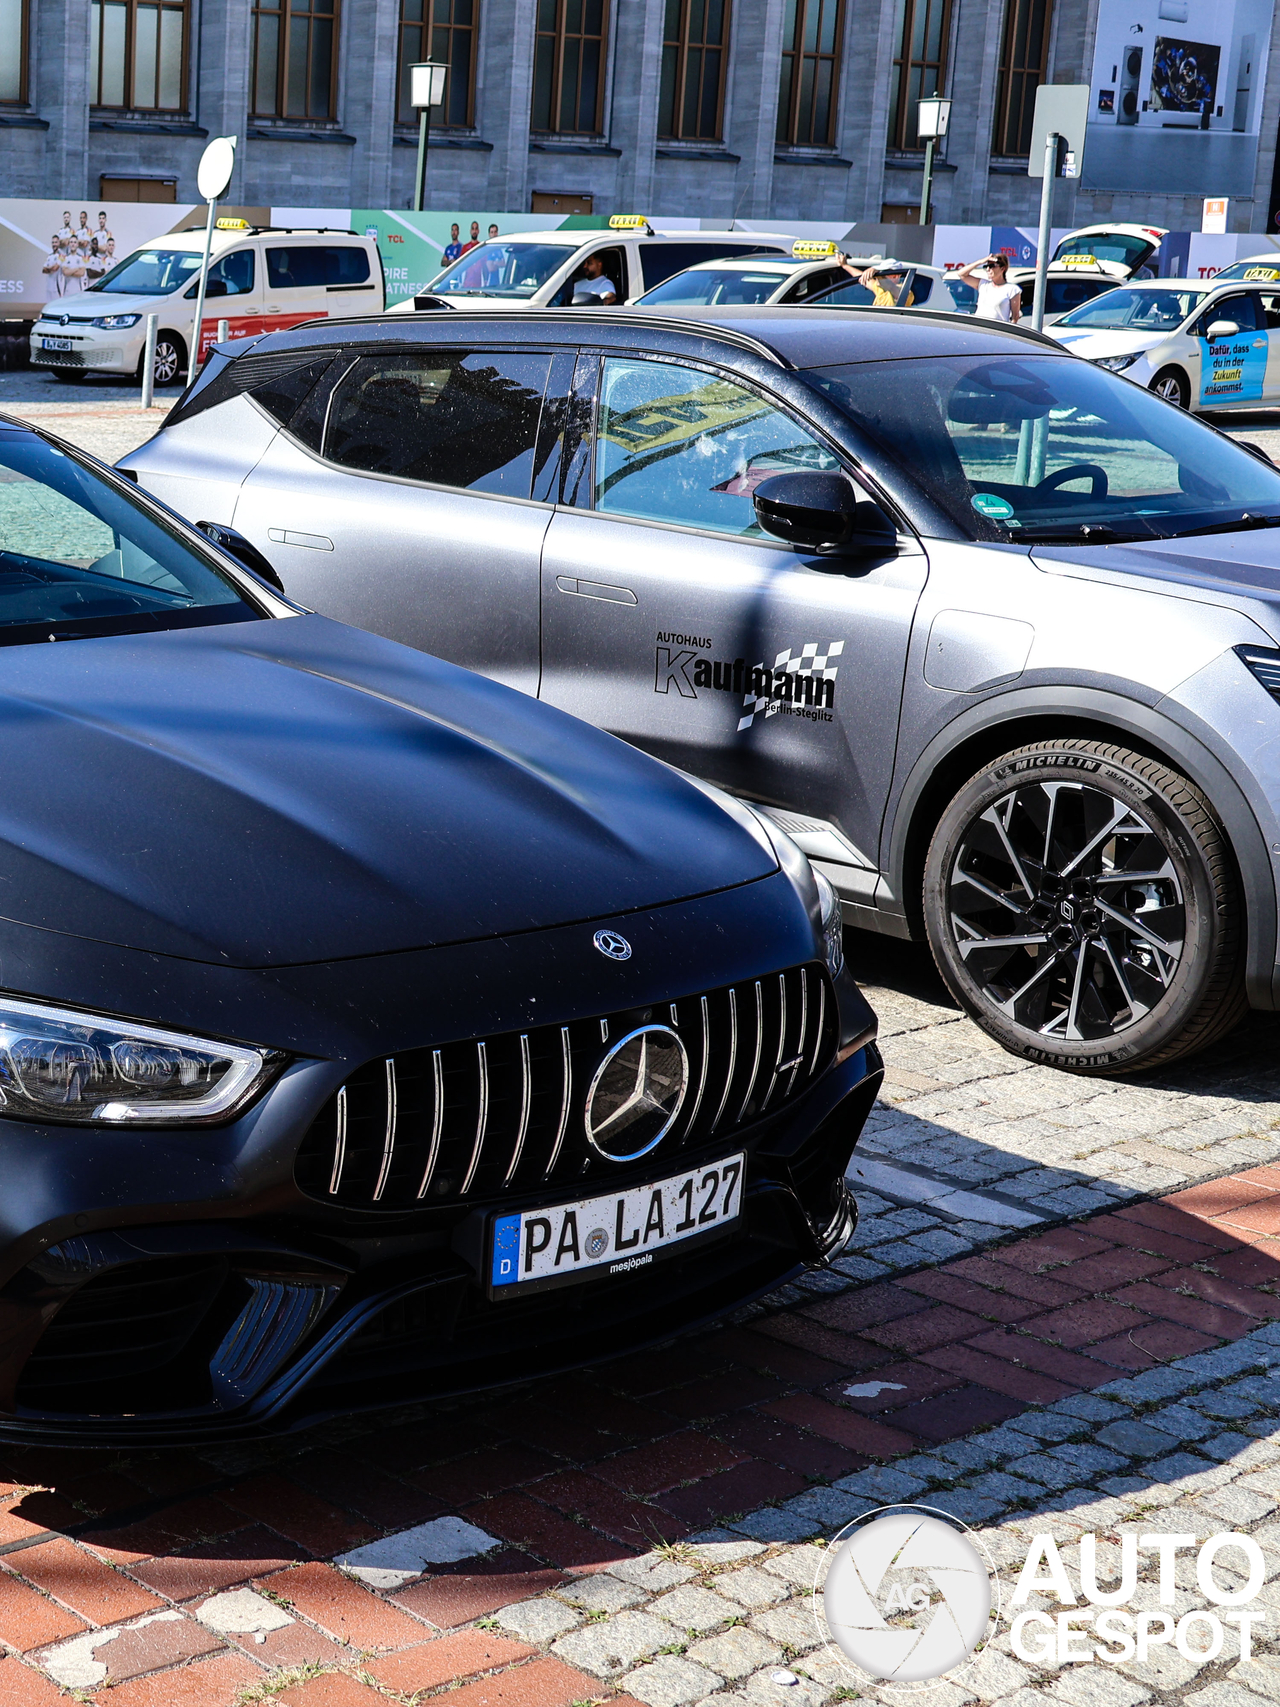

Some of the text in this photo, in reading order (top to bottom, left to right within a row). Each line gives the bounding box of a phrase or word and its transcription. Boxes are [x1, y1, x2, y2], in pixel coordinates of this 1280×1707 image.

[388, 235, 405, 243] TCL
[1000, 247, 1018, 257] TCL
[1246, 268, 1274, 279] TAXI
[1209, 344, 1231, 356] Dafür,
[1233, 344, 1249, 354] dass
[1213, 357, 1245, 368] du in der
[1213, 369, 1241, 381] Zukunft
[1205, 382, 1243, 394] ankommst.
[656, 631, 712, 648] AUTOHAUS
[654, 646, 835, 709] Kaufmann
[764, 701, 834, 722] Berlin-Steglitz
[1015, 756, 1096, 771] MICHELIN
[1104, 769, 1129, 788] 235/45
[1134, 786, 1144, 796] 20
[1028, 1049, 1109, 1066] MICHELIN
[524, 1211, 580, 1273] PA
[615, 1189, 664, 1251] LA
[676, 1161, 741, 1233] 127
[500, 1259, 511, 1275] D
